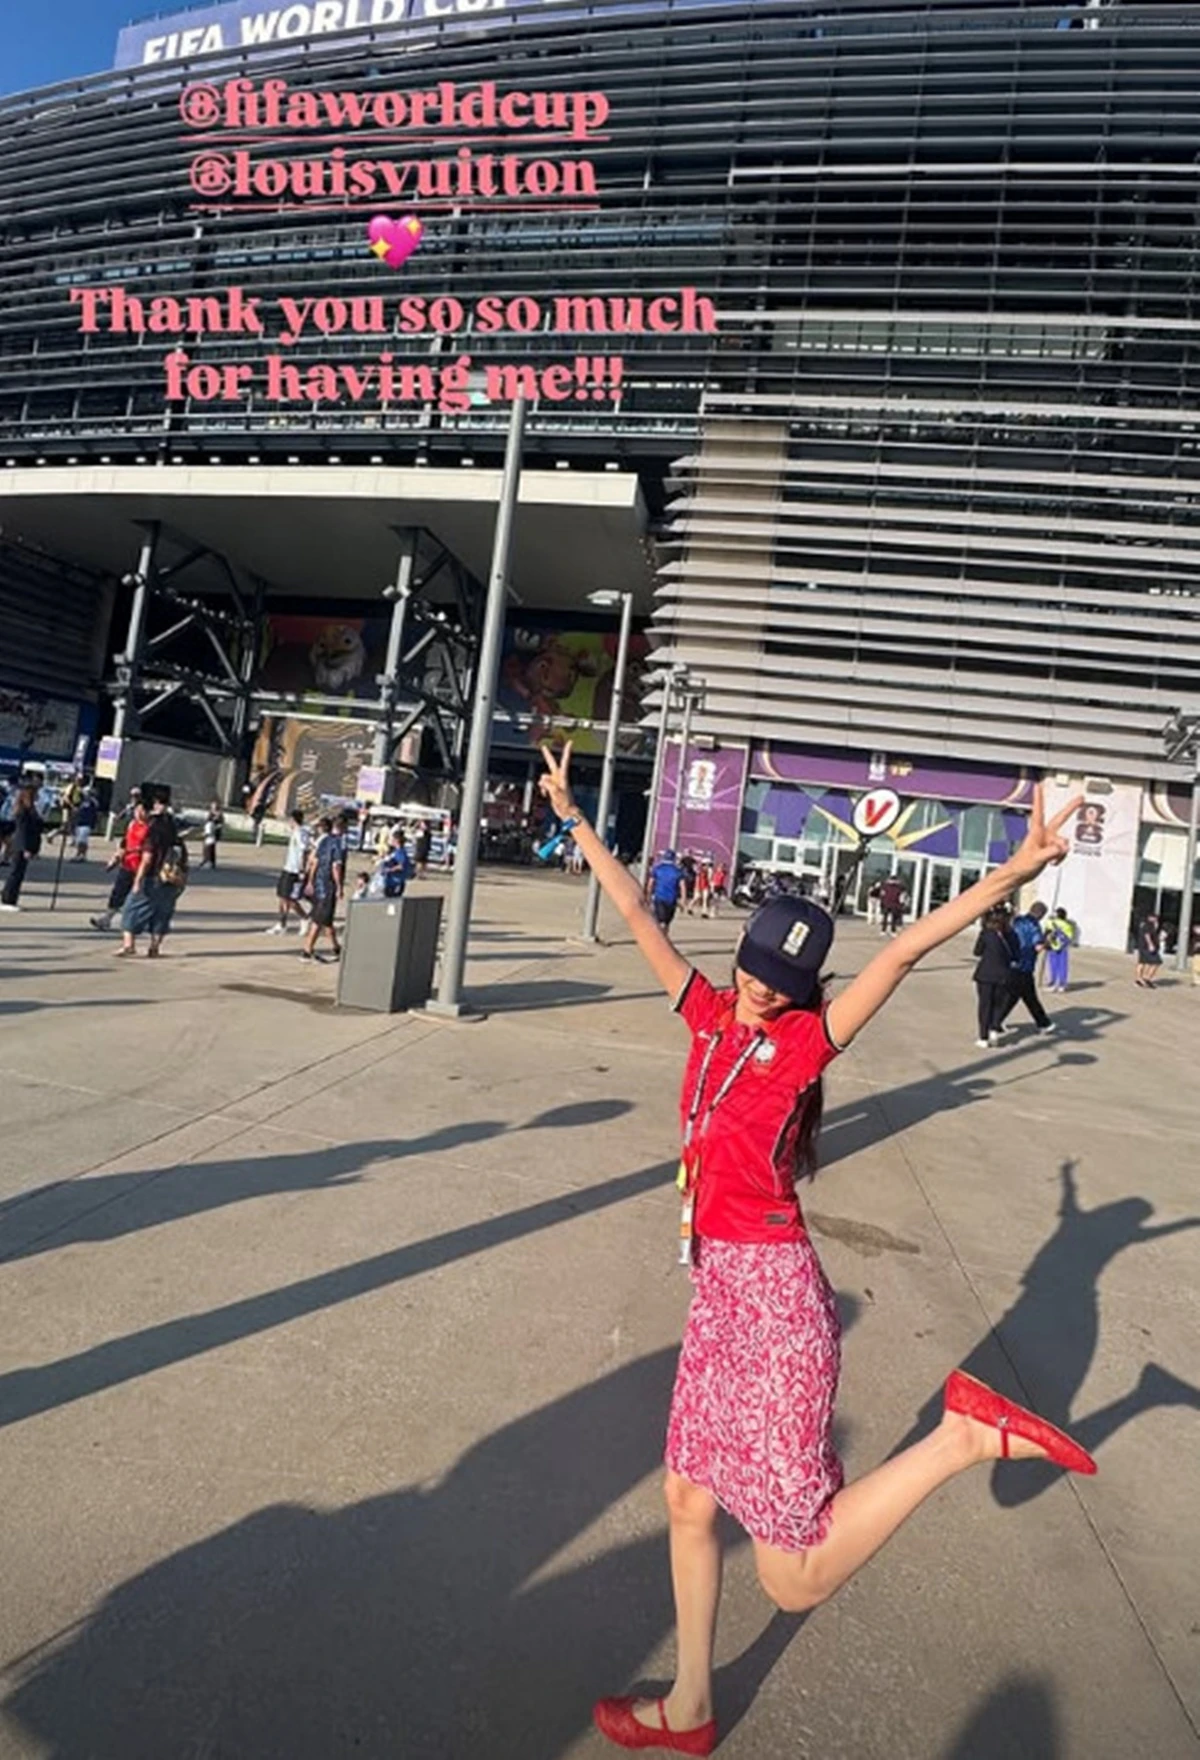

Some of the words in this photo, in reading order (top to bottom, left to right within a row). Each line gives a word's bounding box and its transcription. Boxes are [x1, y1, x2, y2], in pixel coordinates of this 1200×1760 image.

[143, 24, 223, 64] FIFA
[240, 0, 406, 46] WORLD
[865, 798, 893, 827] V
